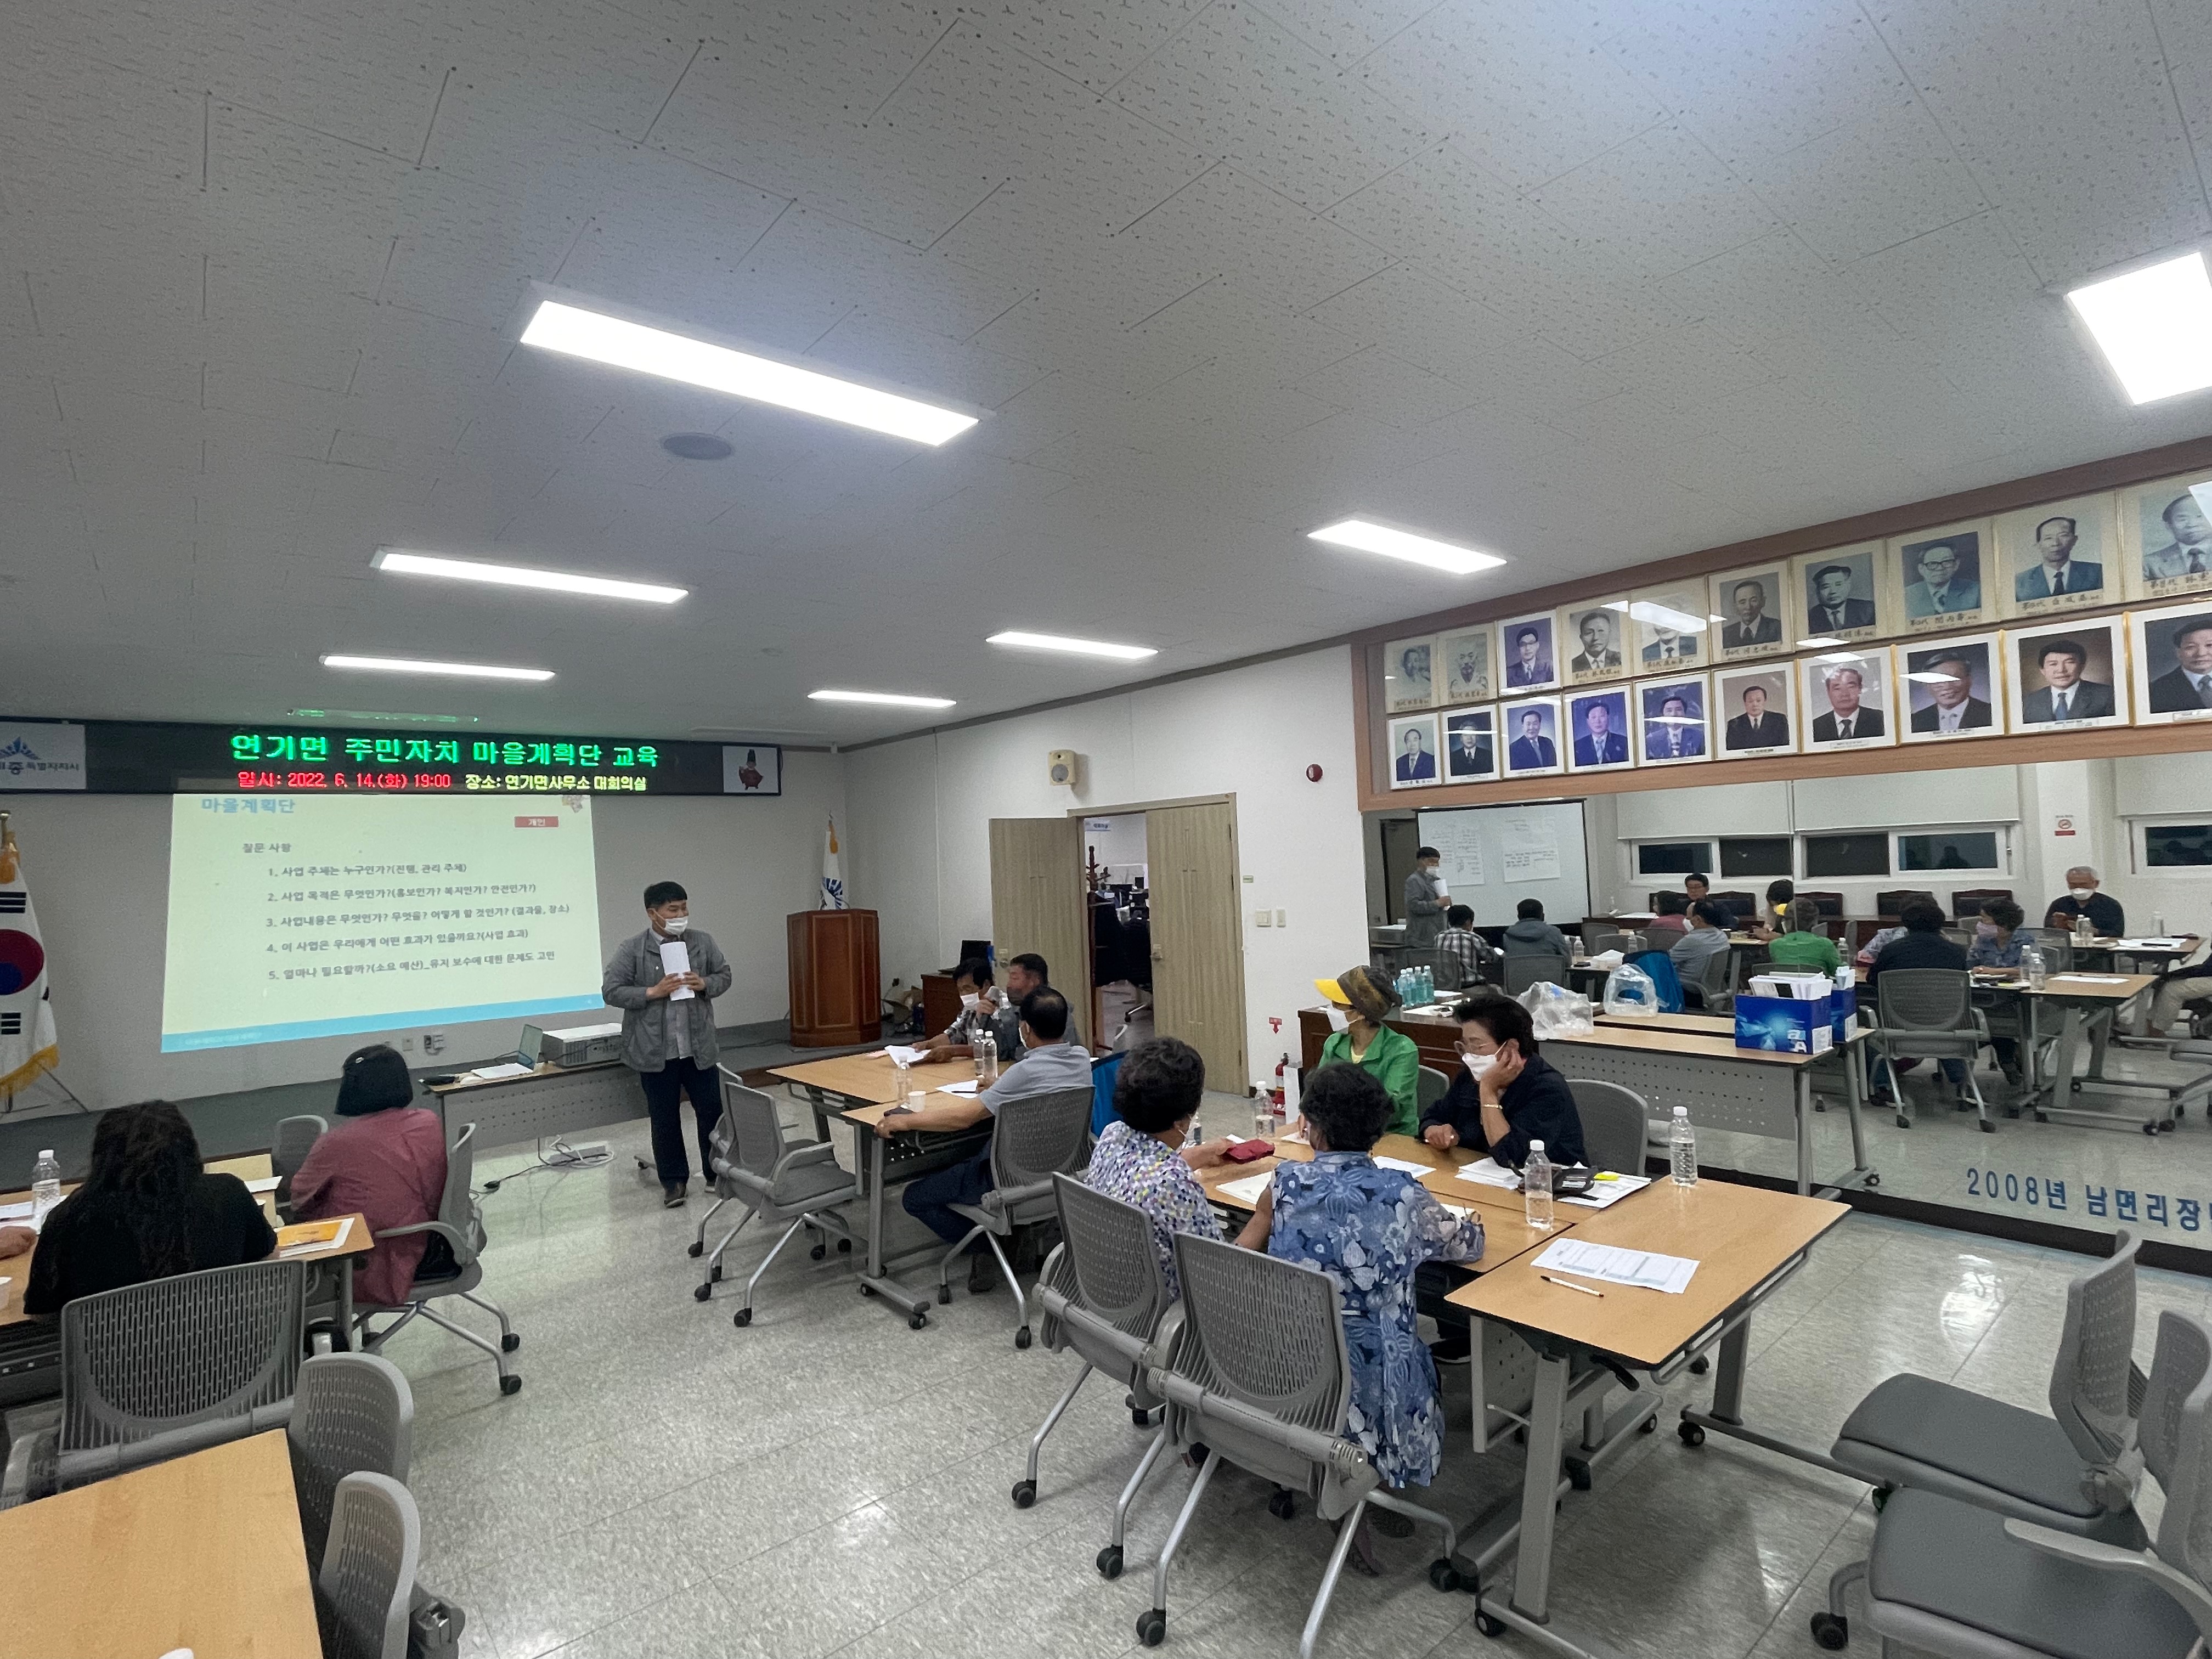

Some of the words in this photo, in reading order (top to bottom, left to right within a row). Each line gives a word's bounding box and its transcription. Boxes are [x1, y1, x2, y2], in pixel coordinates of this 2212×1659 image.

[230, 735, 328, 761] 연기면
[345, 738, 459, 763] 주민자치
[473, 741, 603, 767] 마을계획단
[612, 746, 658, 768] 교육
[238, 771, 281, 788] 일시:
[287, 772, 328, 788] 2022.
[334, 772, 348, 788] 6.
[357, 772, 408, 789] 14.(화)
[414, 774, 452, 788] 19:00
[465, 774, 500, 790] 장소:
[505, 774, 590, 791] 연기면사무소
[594, 775, 647, 791] 대회의실
[201, 798, 295, 814] 마을계획단
[243, 843, 265, 853] 질문
[269, 843, 291, 853] 사항
[269, 868, 278, 877] 1.
[282, 867, 304, 877] 사업
[421, 864, 441, 873] 관리
[268, 893, 278, 901] 2.
[281, 891, 304, 901] 사업
[266, 918, 277, 927] 3.
[267, 944, 278, 953] 4.
[281, 943, 292, 952] 이
[296, 940, 329, 951] 사업은
[334, 937, 376, 949] 우리에게
[380, 936, 400, 947] 어떤
[269, 970, 279, 980] 5.
[537, 951, 555, 960] 고민
[1966, 1167, 2067, 1211] 2008년
[2085, 1184, 2212, 1232] 남면리장
